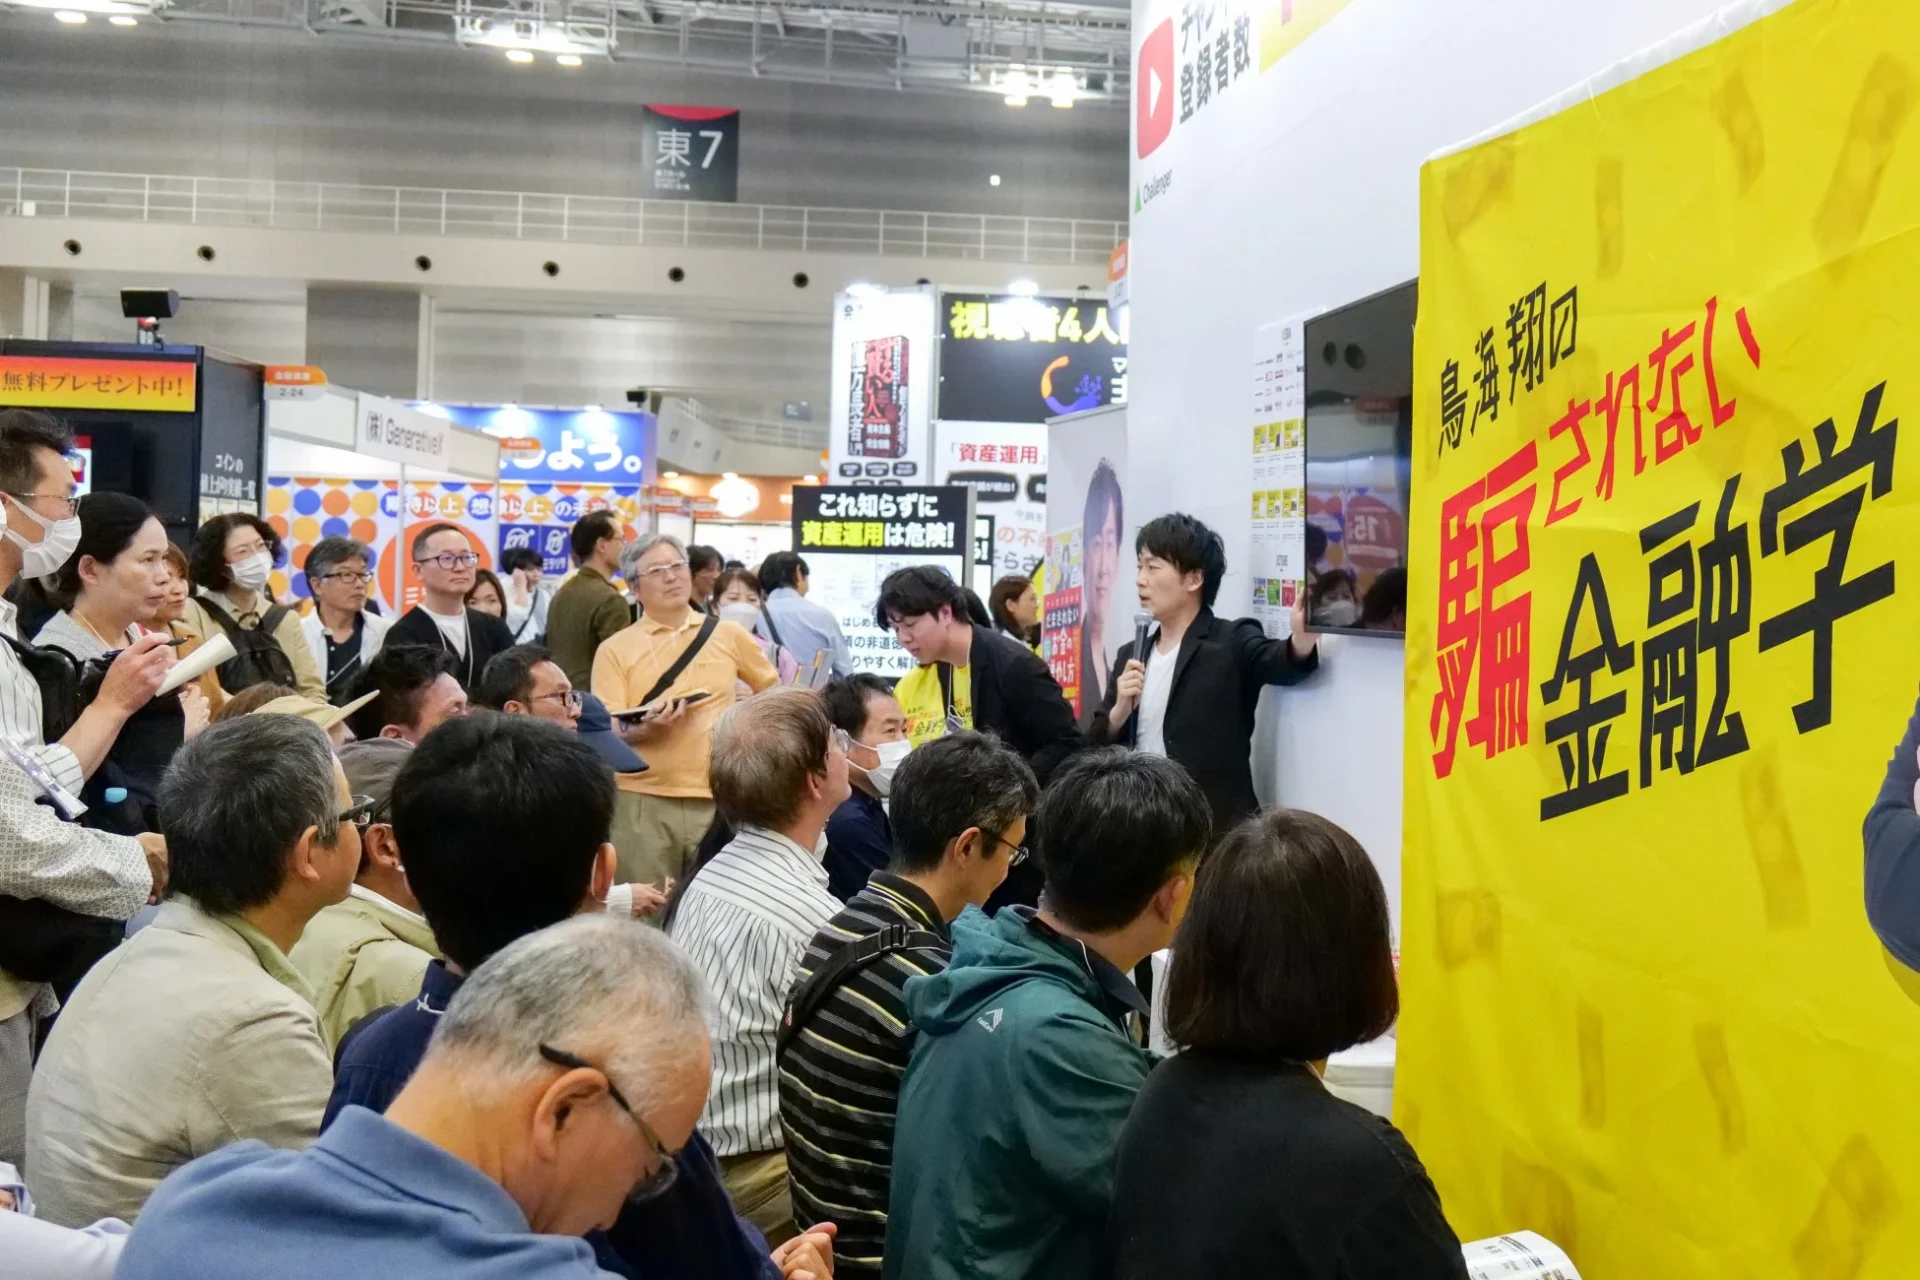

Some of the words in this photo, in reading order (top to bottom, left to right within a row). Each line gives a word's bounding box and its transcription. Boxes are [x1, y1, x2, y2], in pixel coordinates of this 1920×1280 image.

[1179, 12, 1251, 124] 登録者数
[1143, 168, 1173, 205] Challenger
[950, 301, 1130, 345] 視4人
[2, 370, 184, 397] 無料プレゼント中!
[1437, 280, 1579, 459] 鳥海翔の
[215, 452, 244, 475] コインの
[818, 492, 939, 519] これ知らずに
[801, 520, 955, 549] 資産運用は危険!
[1540, 379, 1899, 823] 金融学
